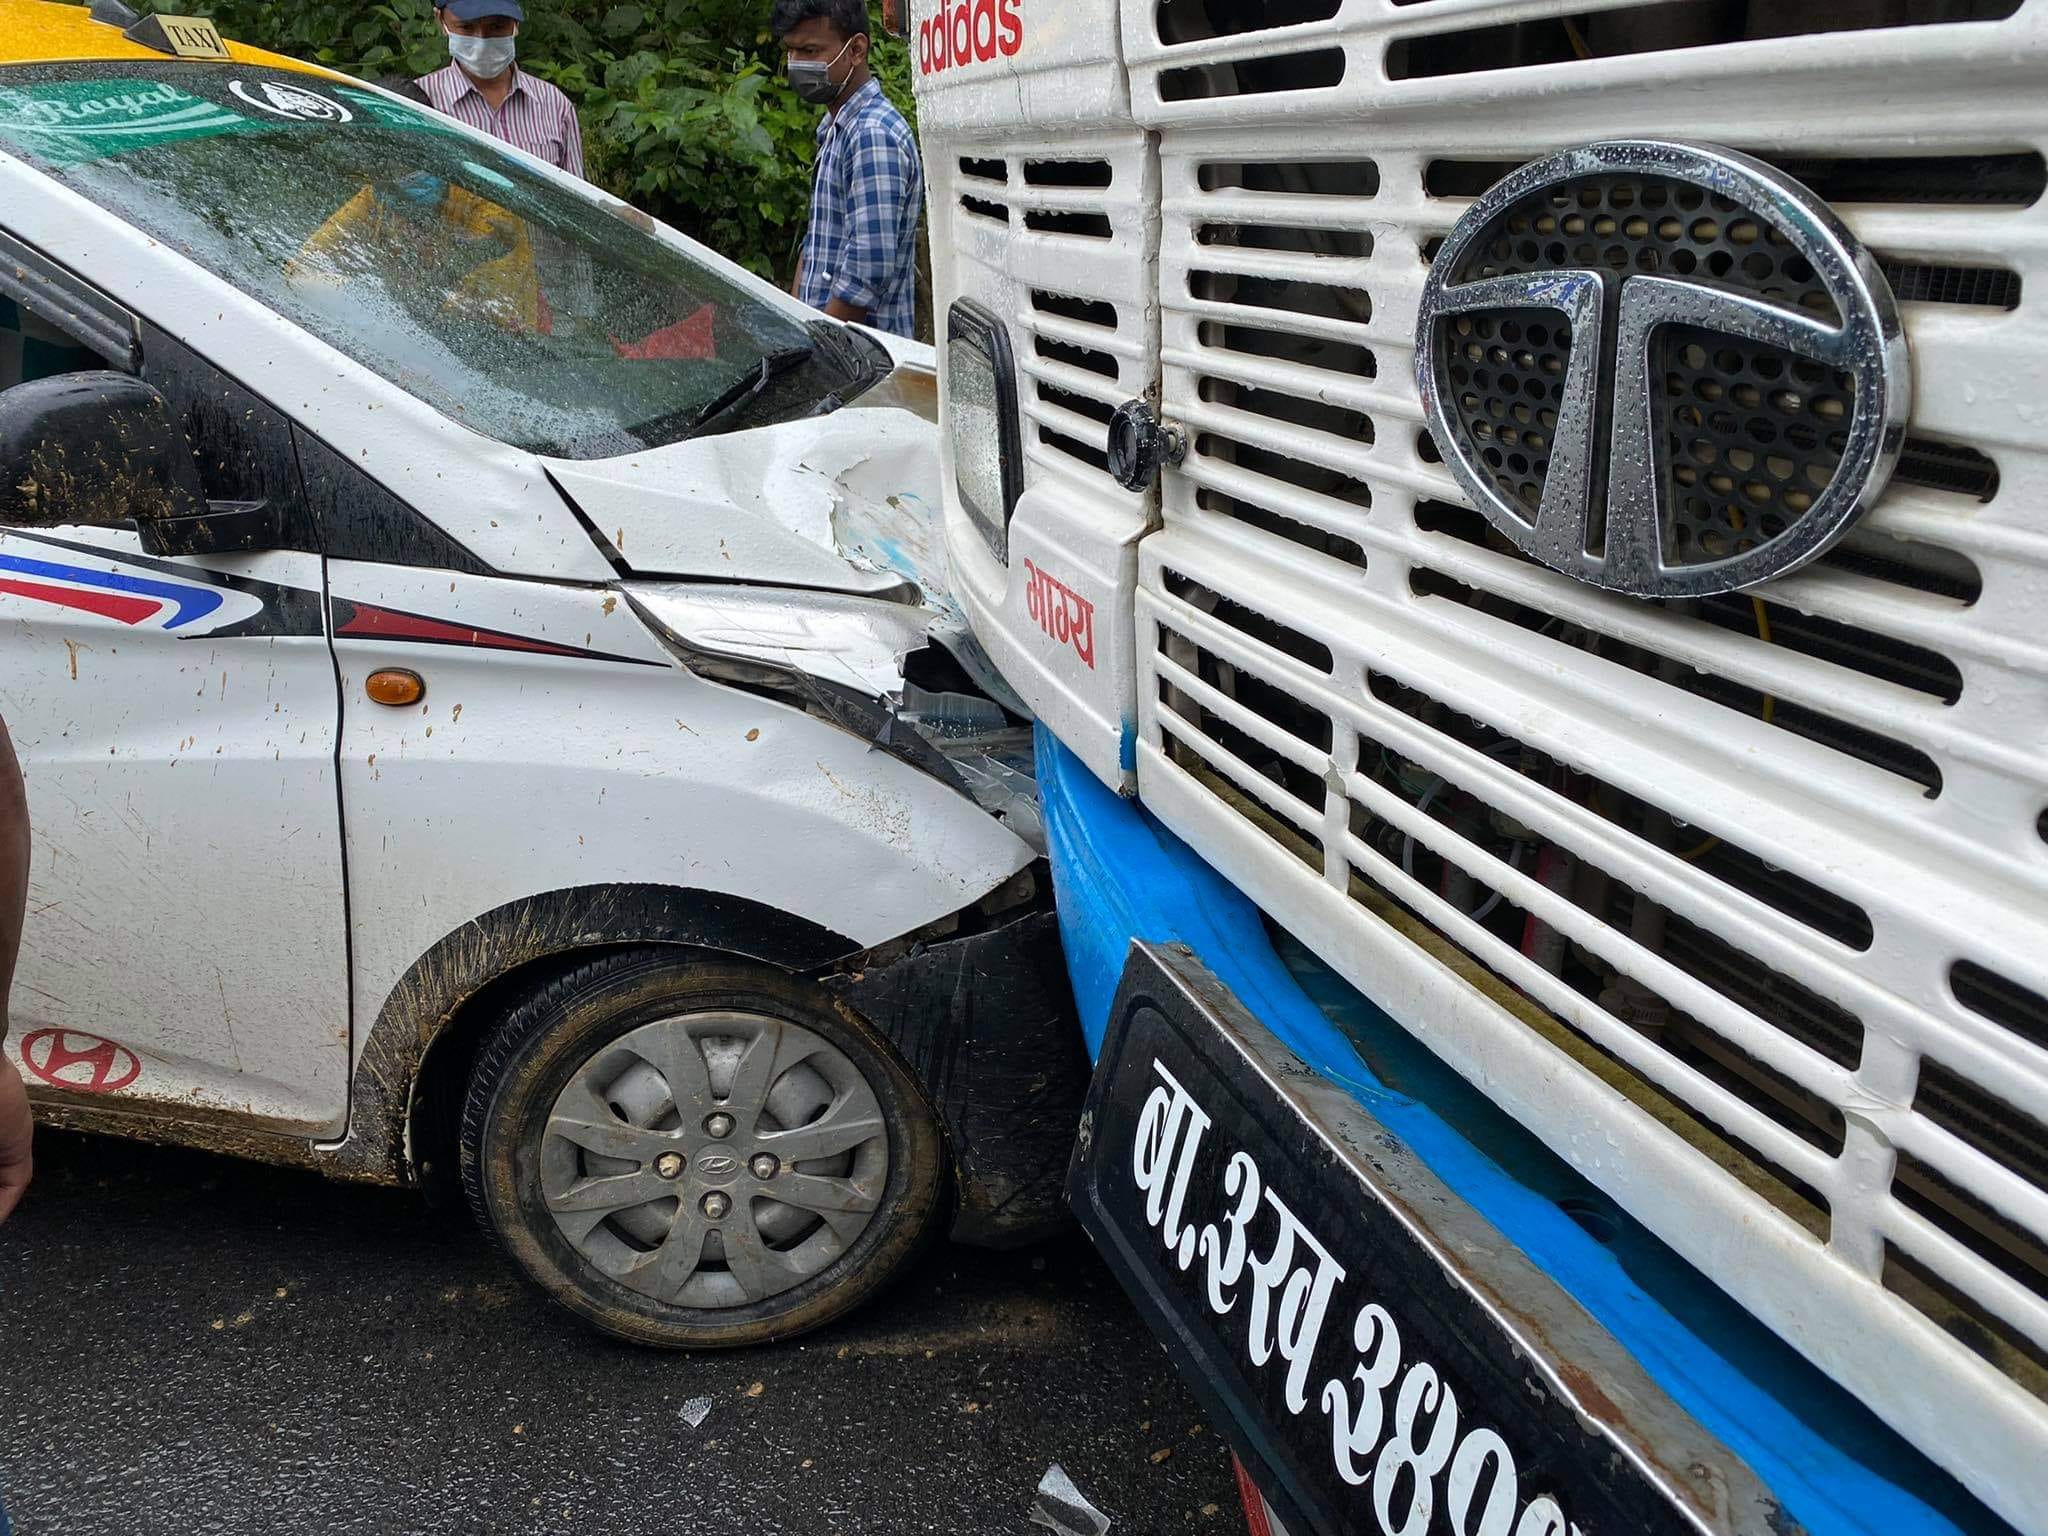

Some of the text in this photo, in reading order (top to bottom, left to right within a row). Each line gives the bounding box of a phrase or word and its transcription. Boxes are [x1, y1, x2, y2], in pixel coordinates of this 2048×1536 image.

[167, 25, 219, 51] TAXI
[919, 0, 1023, 76] adidas
[31, 83, 192, 124] Royal
[1321, 1302, 1586, 1536] ३४०
